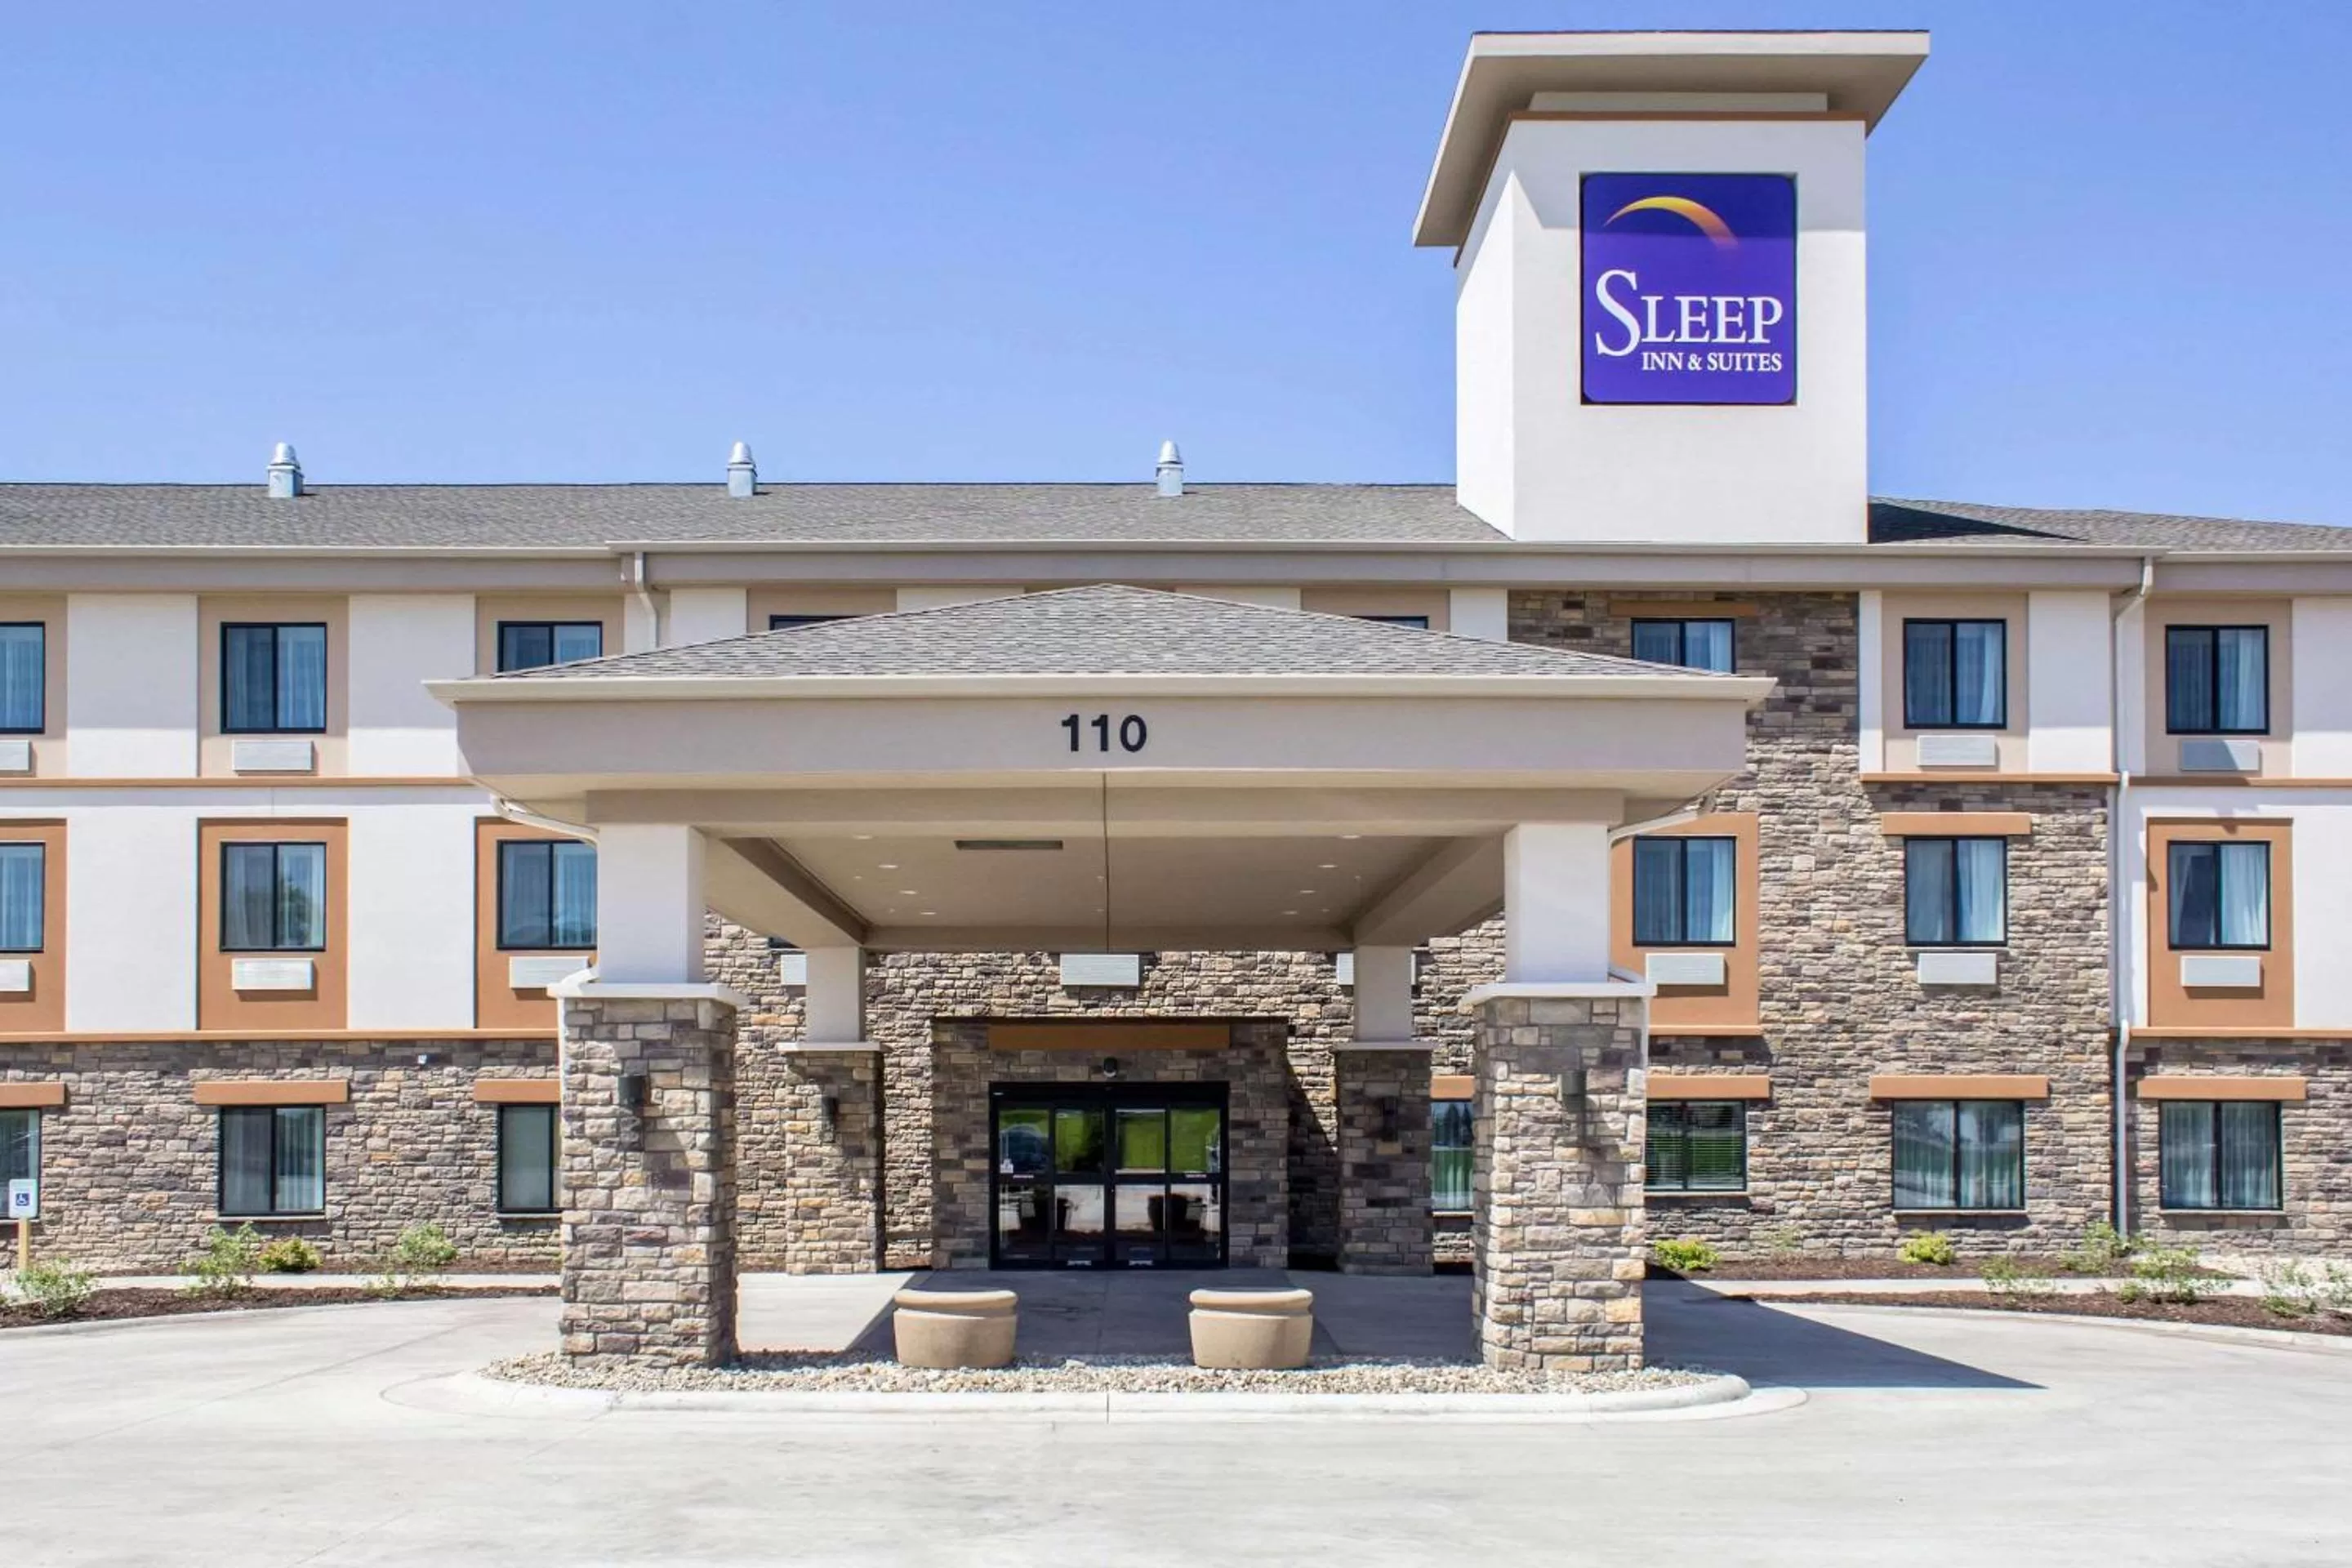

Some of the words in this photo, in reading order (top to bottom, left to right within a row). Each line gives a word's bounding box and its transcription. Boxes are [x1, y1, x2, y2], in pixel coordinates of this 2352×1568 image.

[1596, 270, 1783, 357] SLEEP
[1642, 352, 1683, 371] INN
[1688, 353, 1702, 371] &
[1708, 352, 1782, 372] SUITES
[1061, 714, 1147, 752] 110
